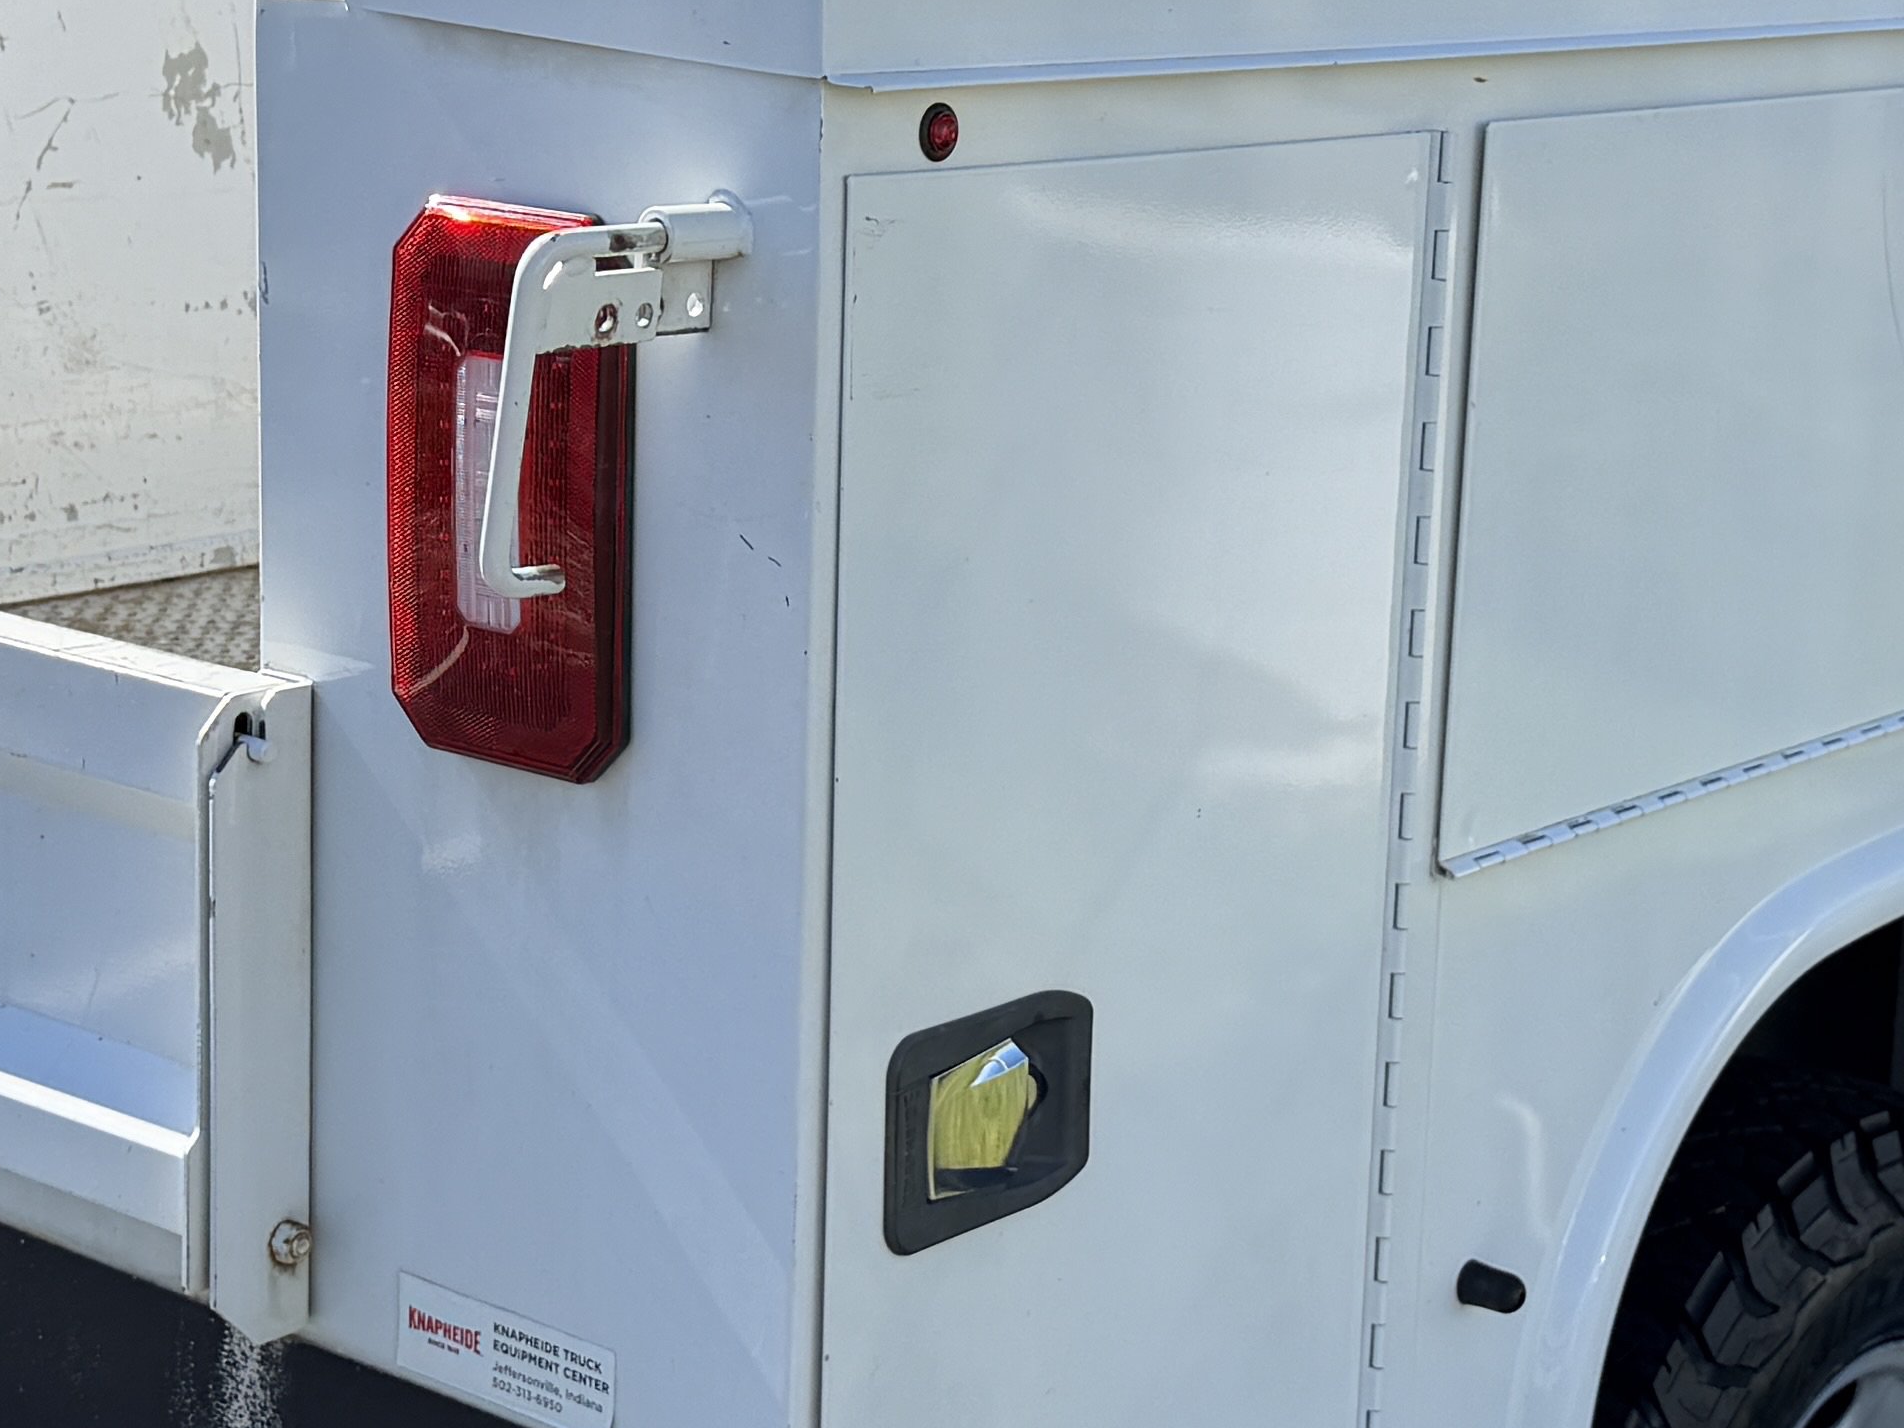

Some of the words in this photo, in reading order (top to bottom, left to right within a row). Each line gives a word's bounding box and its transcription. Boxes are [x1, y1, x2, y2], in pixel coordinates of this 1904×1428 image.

[408, 1304, 482, 1356] KNAPHEIDE
[493, 1321, 560, 1358] KNAPHEIDE
[563, 1348, 603, 1374] TRUCK
[492, 1360, 563, 1399] Jeffersonville,
[565, 1388, 604, 1413] Indiana
[493, 1338, 560, 1374] EQUIPMENT
[563, 1366, 610, 1395] CENTER
